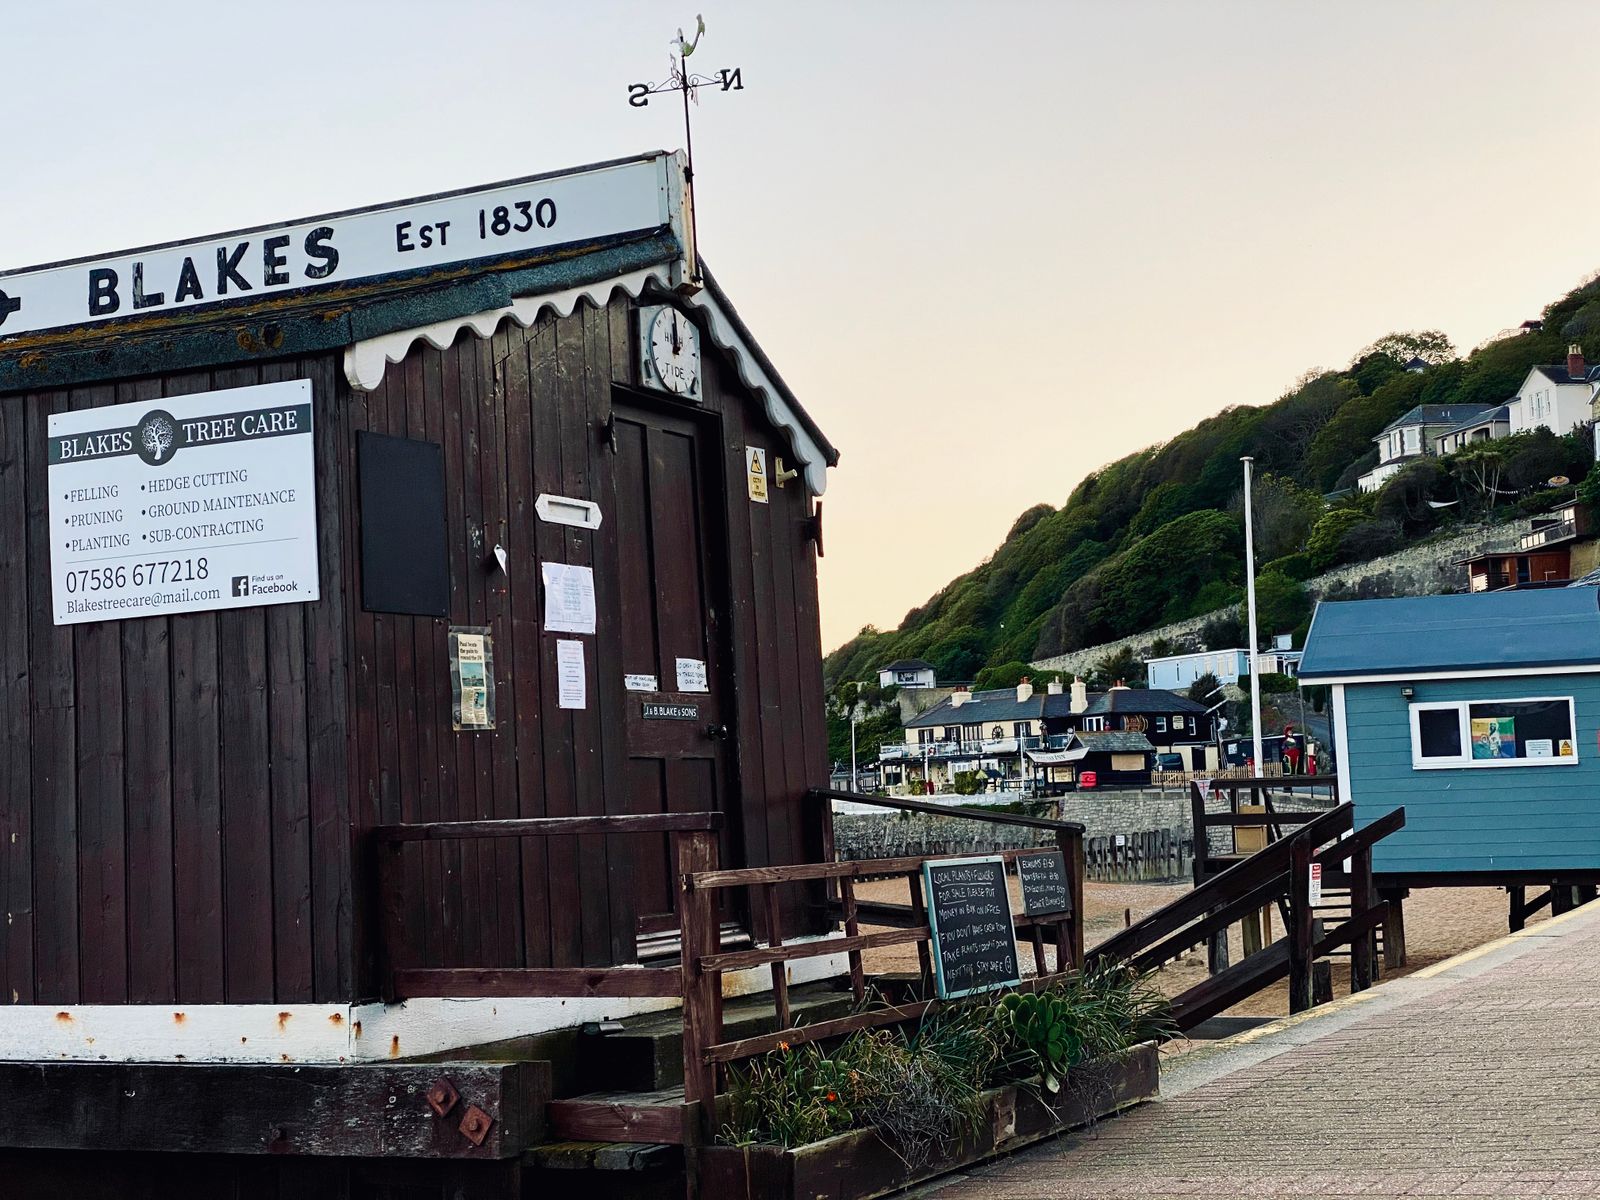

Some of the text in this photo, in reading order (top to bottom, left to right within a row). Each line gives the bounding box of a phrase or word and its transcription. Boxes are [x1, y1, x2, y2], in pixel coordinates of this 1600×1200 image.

[88, 197, 557, 317] BLAKES EST 1830
[664, 362, 686, 381] TIDE
[60, 410, 298, 459] BLAKES TREE CARE
[148, 469, 248, 493] HEDGE CUTTING
[70, 485, 119, 502] FELLING
[148, 489, 296, 518] GROUND MAINTENANCE
[71, 509, 123, 527] PRUNING
[149, 518, 264, 543] SUB-CONTRACTING
[72, 534, 130, 552] PLANTING
[66, 558, 209, 594] 07586 677218
[252, 575, 265, 583] Find
[251, 580, 298, 595] Facebook
[67, 588, 220, 614] Blakestreecare@mail.com
[659, 706, 677, 717] BLAKE
[681, 707, 697, 717] SONS
[934, 872, 951, 885] LOCAL
[951, 870, 971, 882] PLANTS
[938, 887, 995, 902] FOR SALE PLEASE PUT
[938, 908, 957, 921] MONEY
[942, 948, 960, 963] TAKE
[976, 960, 989, 973] STAY
